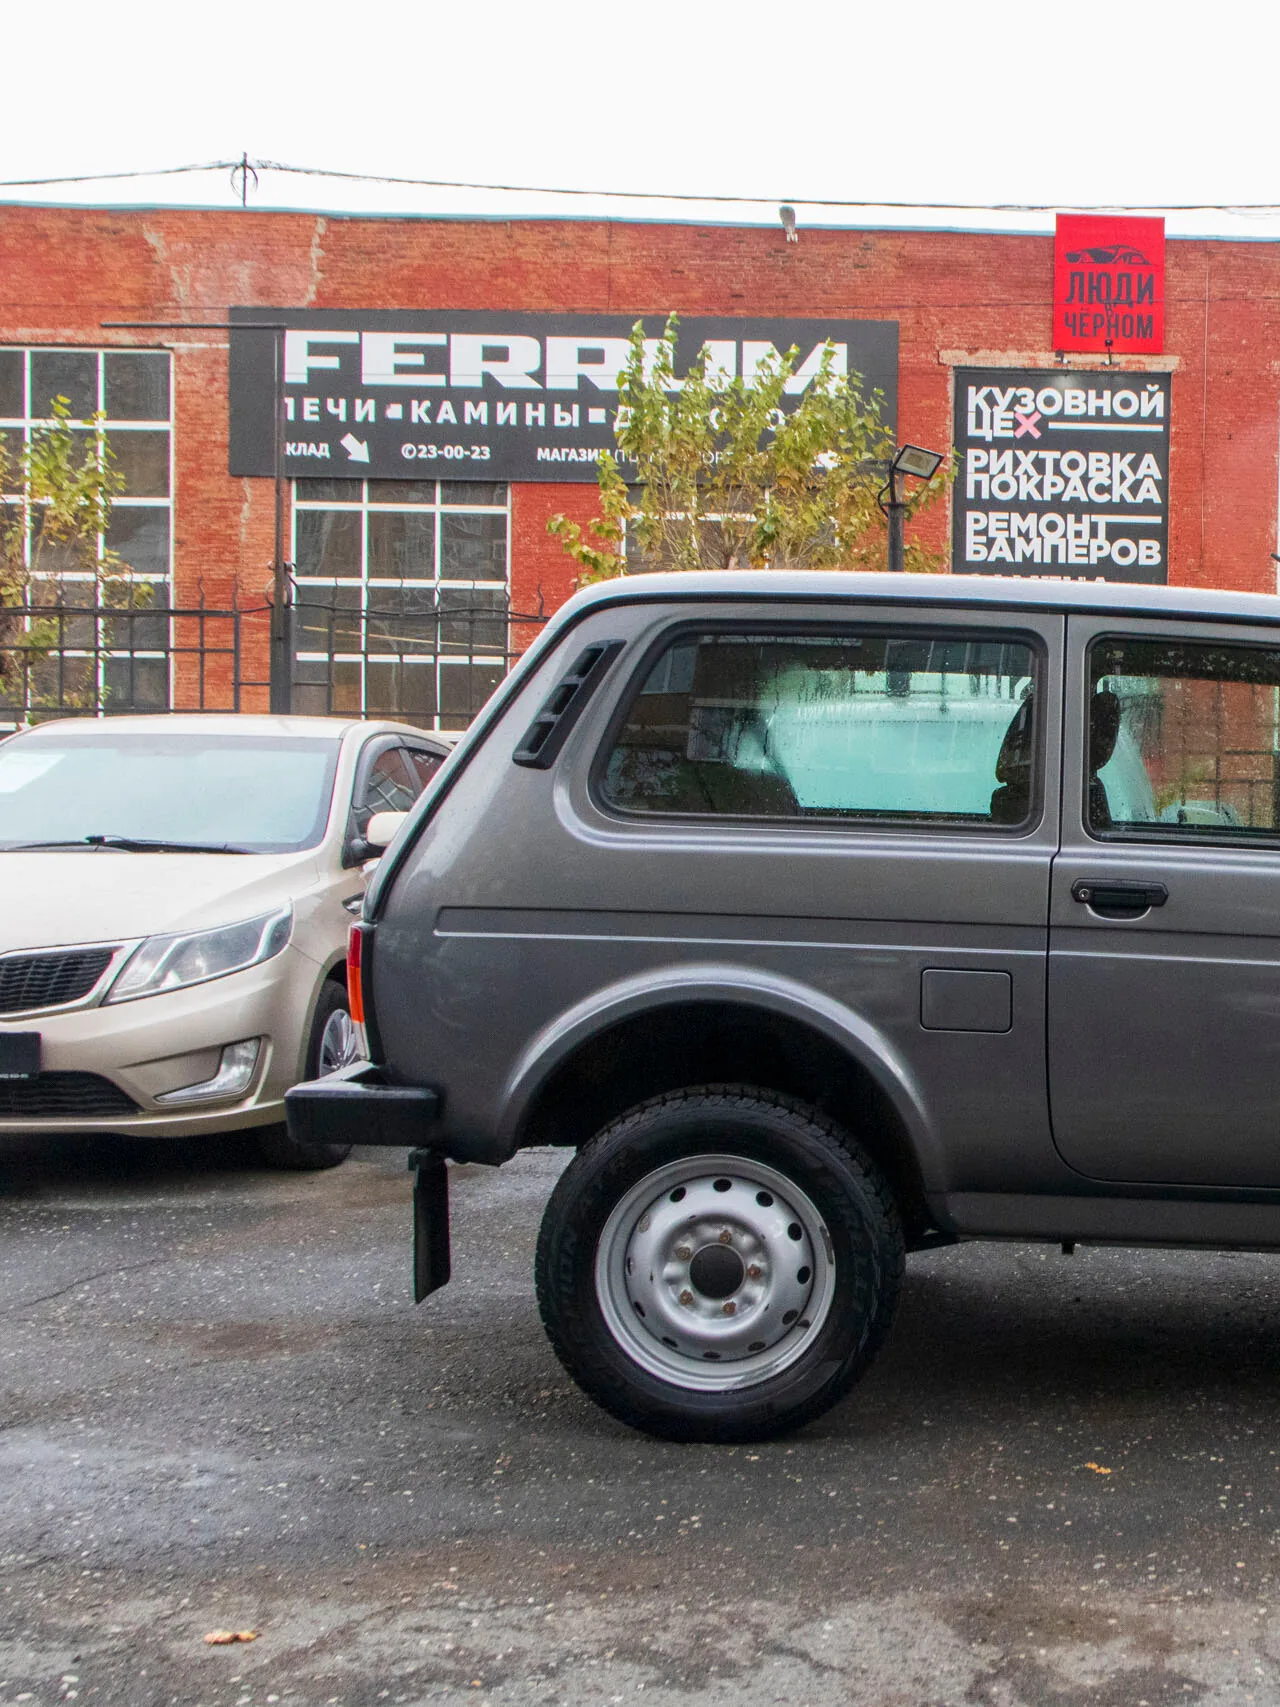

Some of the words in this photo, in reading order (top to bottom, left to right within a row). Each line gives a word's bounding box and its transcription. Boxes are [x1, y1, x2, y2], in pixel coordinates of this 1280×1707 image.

[1065, 271, 1154, 308] ЛЮДИ
[1064, 307, 1154, 339] ЧЁРНОМ
[284, 329, 848, 396] FERRUM
[411, 400, 580, 428] КАМИНЫ
[967, 384, 1165, 418] КУЗОВНОЙ
[967, 408, 1042, 442] ЦЕХ
[284, 441, 331, 460] КЛАД
[967, 448, 1162, 480] РИХТОВКА
[966, 472, 1162, 504] ПОКРАСКА
[966, 511, 1108, 545] РЕМОНТ
[966, 536, 1162, 566] БАМПЕРОВ
